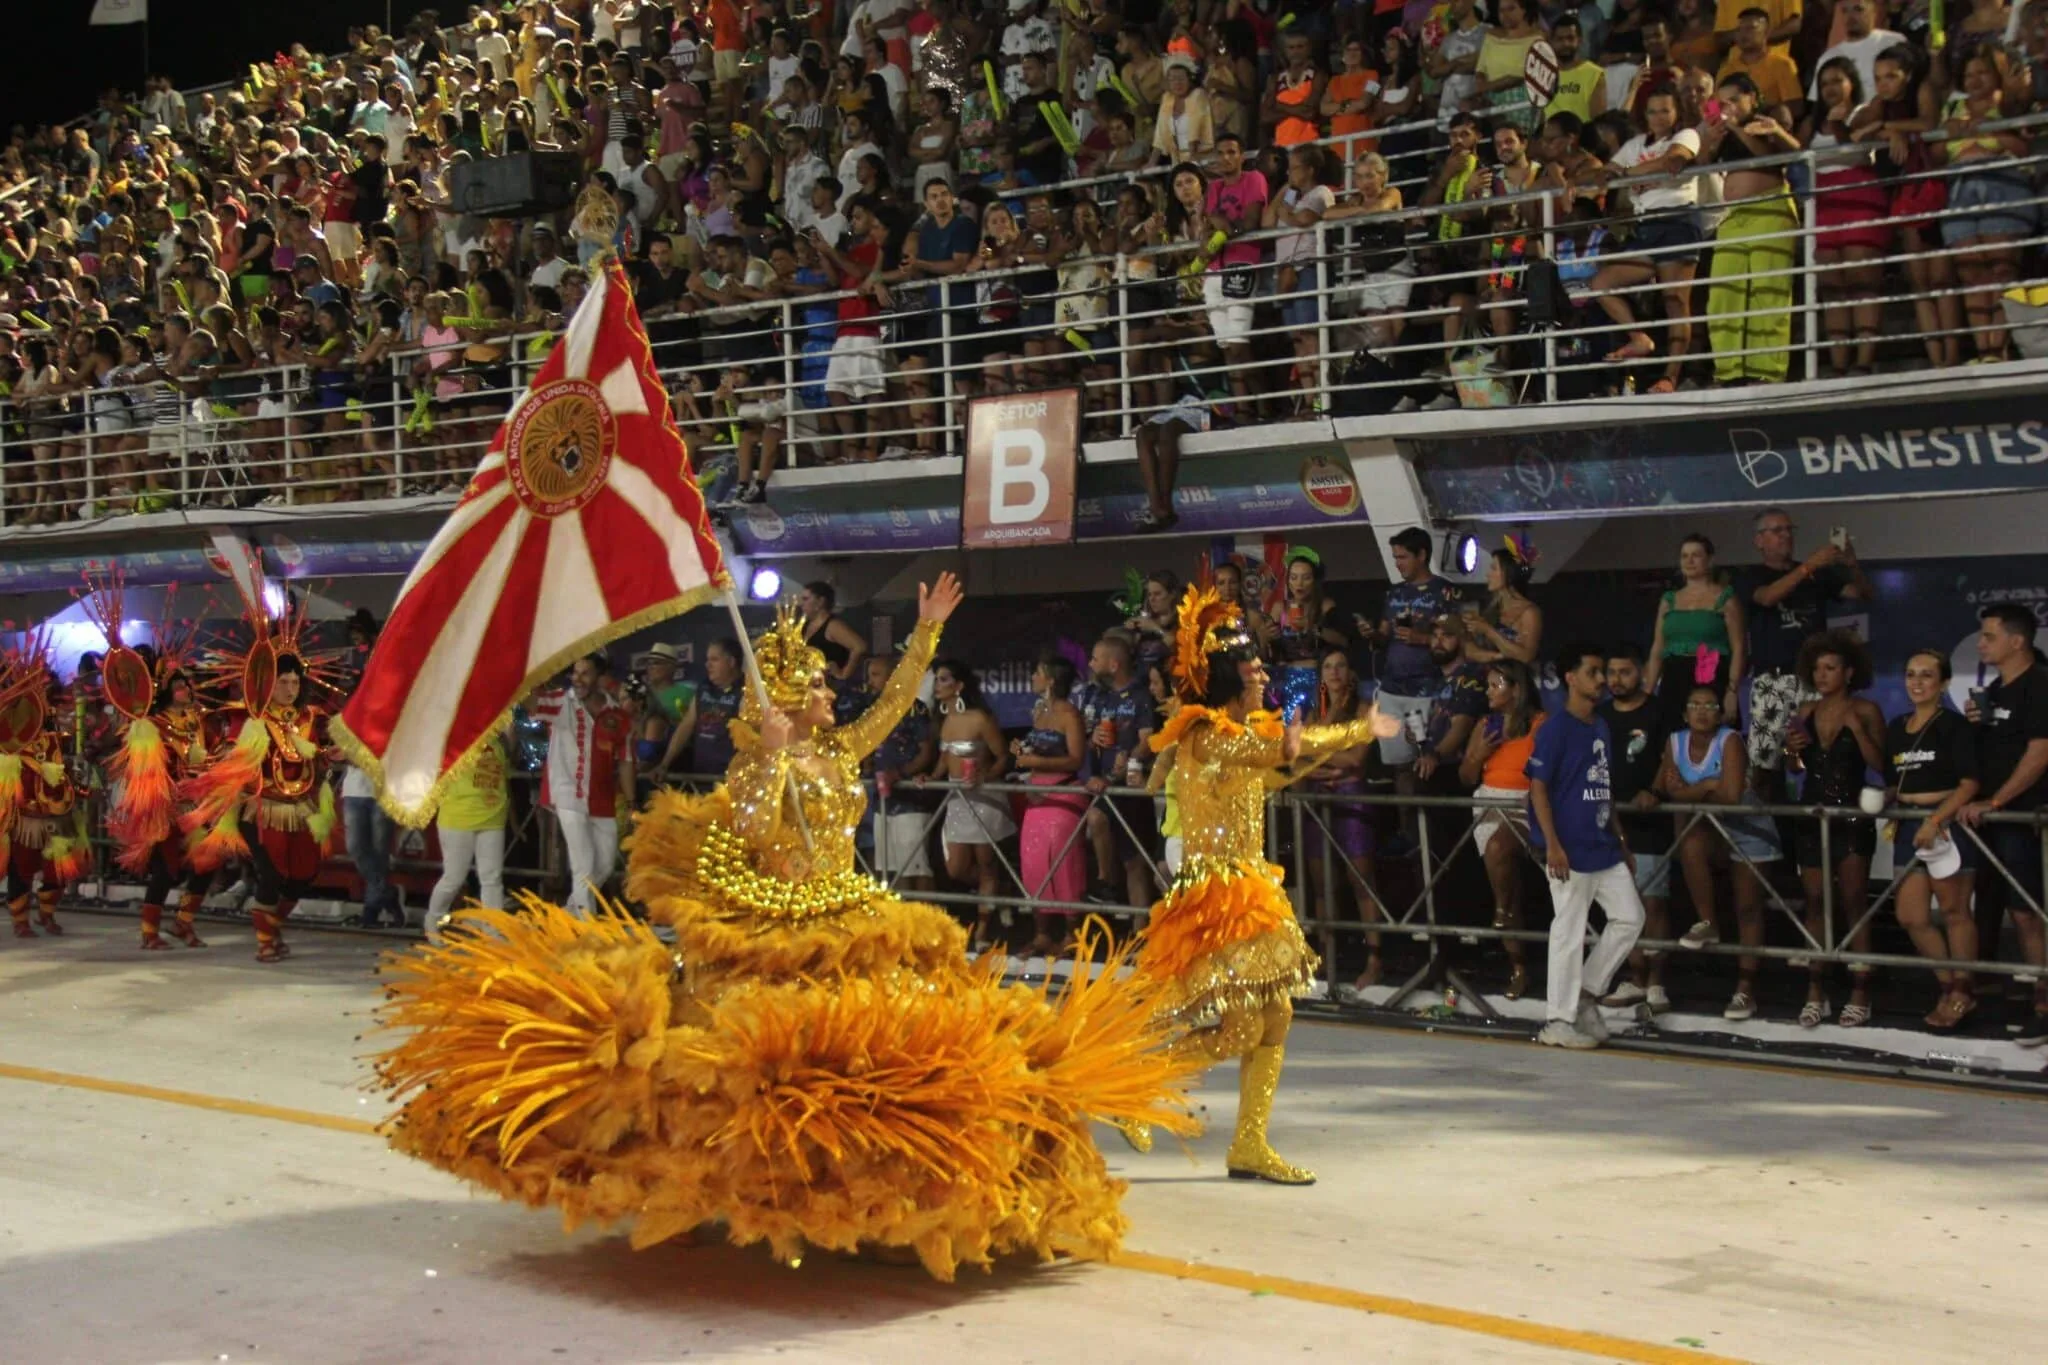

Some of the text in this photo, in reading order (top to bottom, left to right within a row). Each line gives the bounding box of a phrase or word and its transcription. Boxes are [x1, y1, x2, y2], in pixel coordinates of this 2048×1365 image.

[510, 398, 542, 460] MOCIDADE
[542, 383, 576, 400] UNIDA
[999, 402, 1048, 420] SETOR
[1797, 420, 2048, 475] BANESTES
[989, 428, 1050, 524] B
[1310, 474, 1346, 488] AMSTEL
[983, 526, 1052, 540] ARQUIBANCADA
